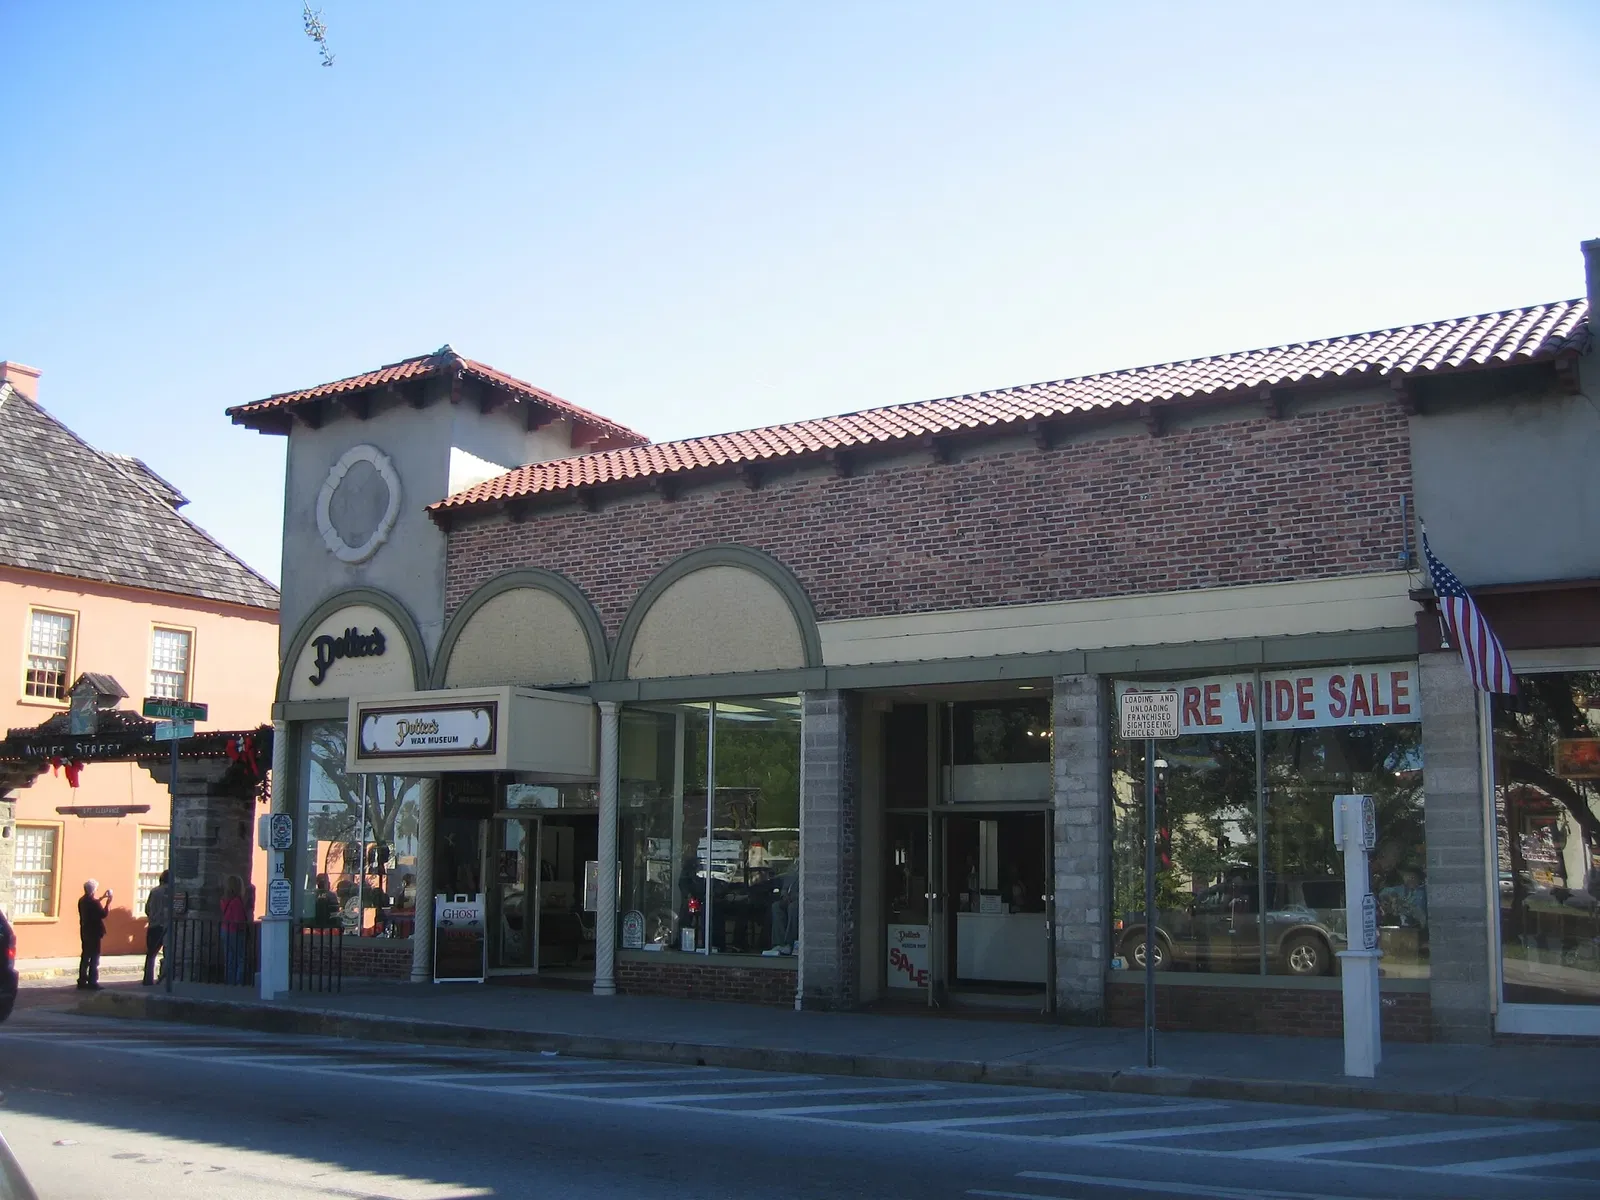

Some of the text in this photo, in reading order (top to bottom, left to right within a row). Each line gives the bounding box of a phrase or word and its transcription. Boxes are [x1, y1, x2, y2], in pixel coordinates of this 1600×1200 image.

[309, 626, 386, 686] Potter's
[1235, 677, 1316, 726] WIDE
[1327, 670, 1411, 719] SALE
[156, 707, 185, 718] AVILES
[1130, 704, 1169, 712] UNLOADING
[1127, 713, 1171, 721] FRANCHISED
[1126, 721, 1172, 729] SIGHTSEEING
[395, 718, 439, 747] Potter's
[1122, 729, 1155, 737] VEHICLES
[428, 736, 459, 744] MUSEUM
[76, 743, 121, 754] STREET
[275, 862, 285, 873] 15
[442, 908, 479, 919] GHOST
[889, 947, 929, 988] SALE
